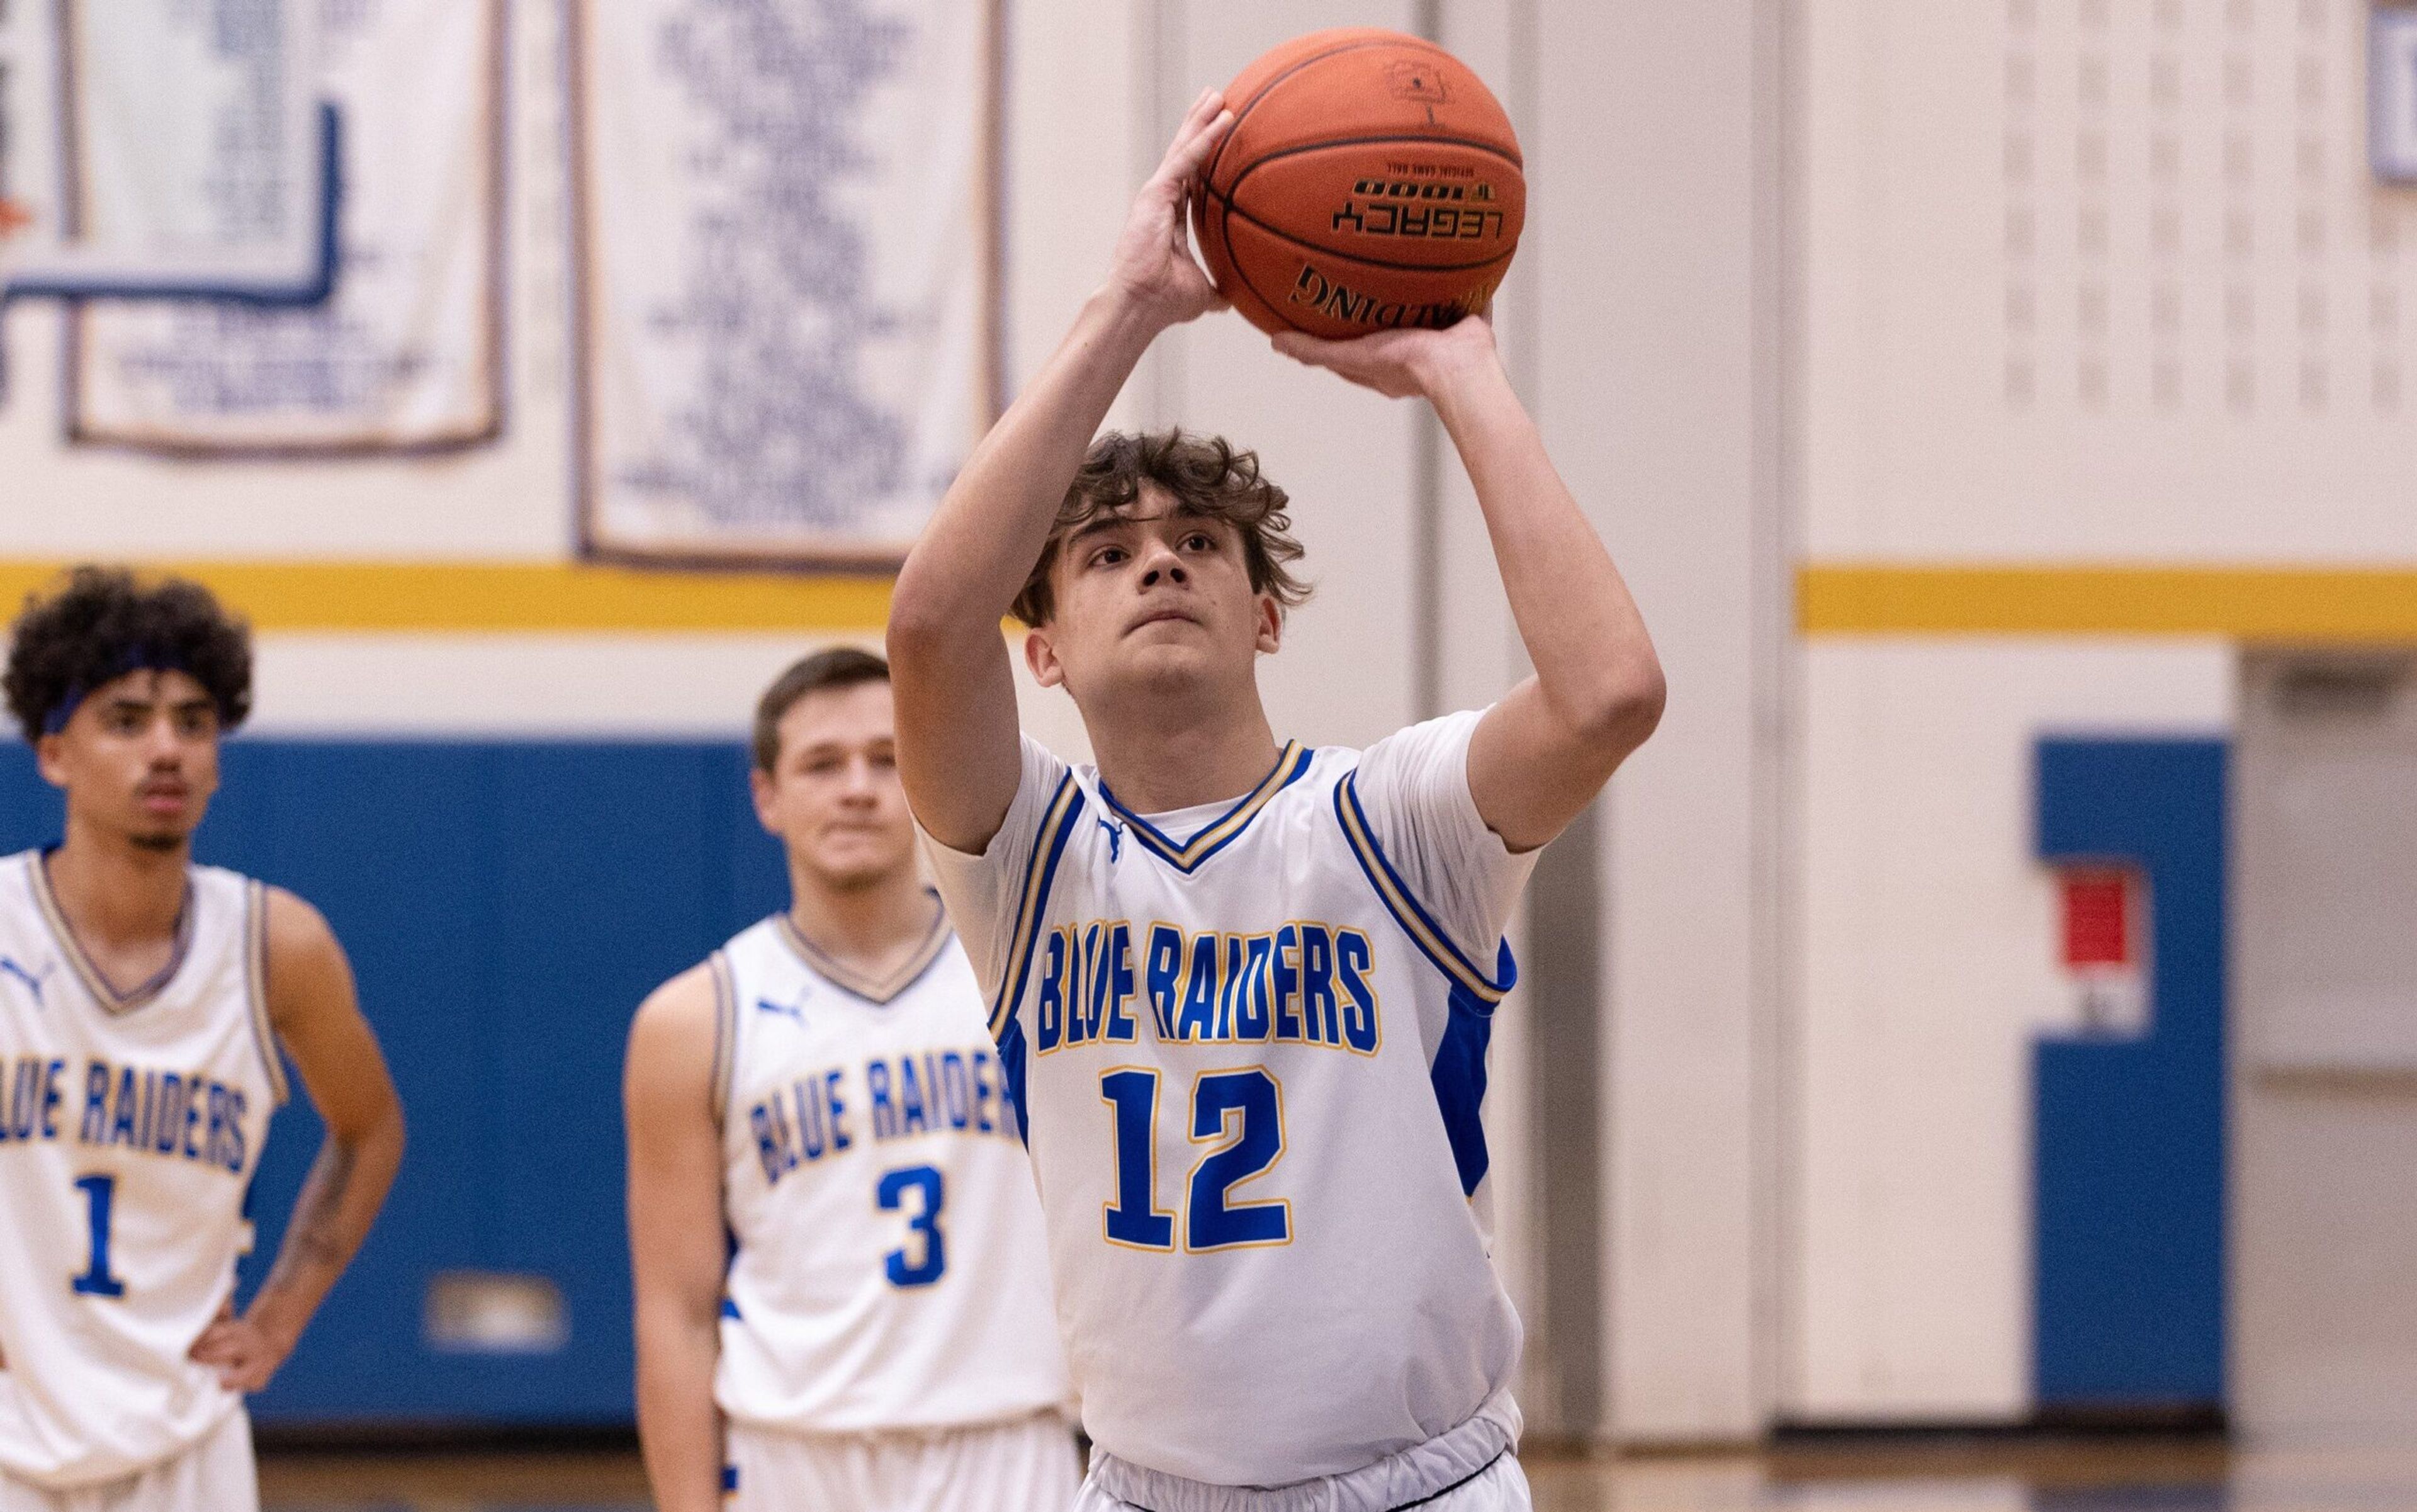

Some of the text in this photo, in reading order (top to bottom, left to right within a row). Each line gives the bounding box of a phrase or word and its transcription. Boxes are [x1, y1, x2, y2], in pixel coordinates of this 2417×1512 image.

[1331, 201, 1503, 239] LEGACY
[1353, 179, 1465, 200] 1000
[1288, 263, 1488, 330] ALDING
[1036, 918, 1382, 1058] BLUE RAIDERS
[0, 1056, 247, 1172] LUE RAIDERS
[750, 1068, 851, 1187] BLUE
[1098, 1064, 1294, 1254] 12
[72, 1175, 124, 1296] 1
[877, 1165, 945, 1287] 3
